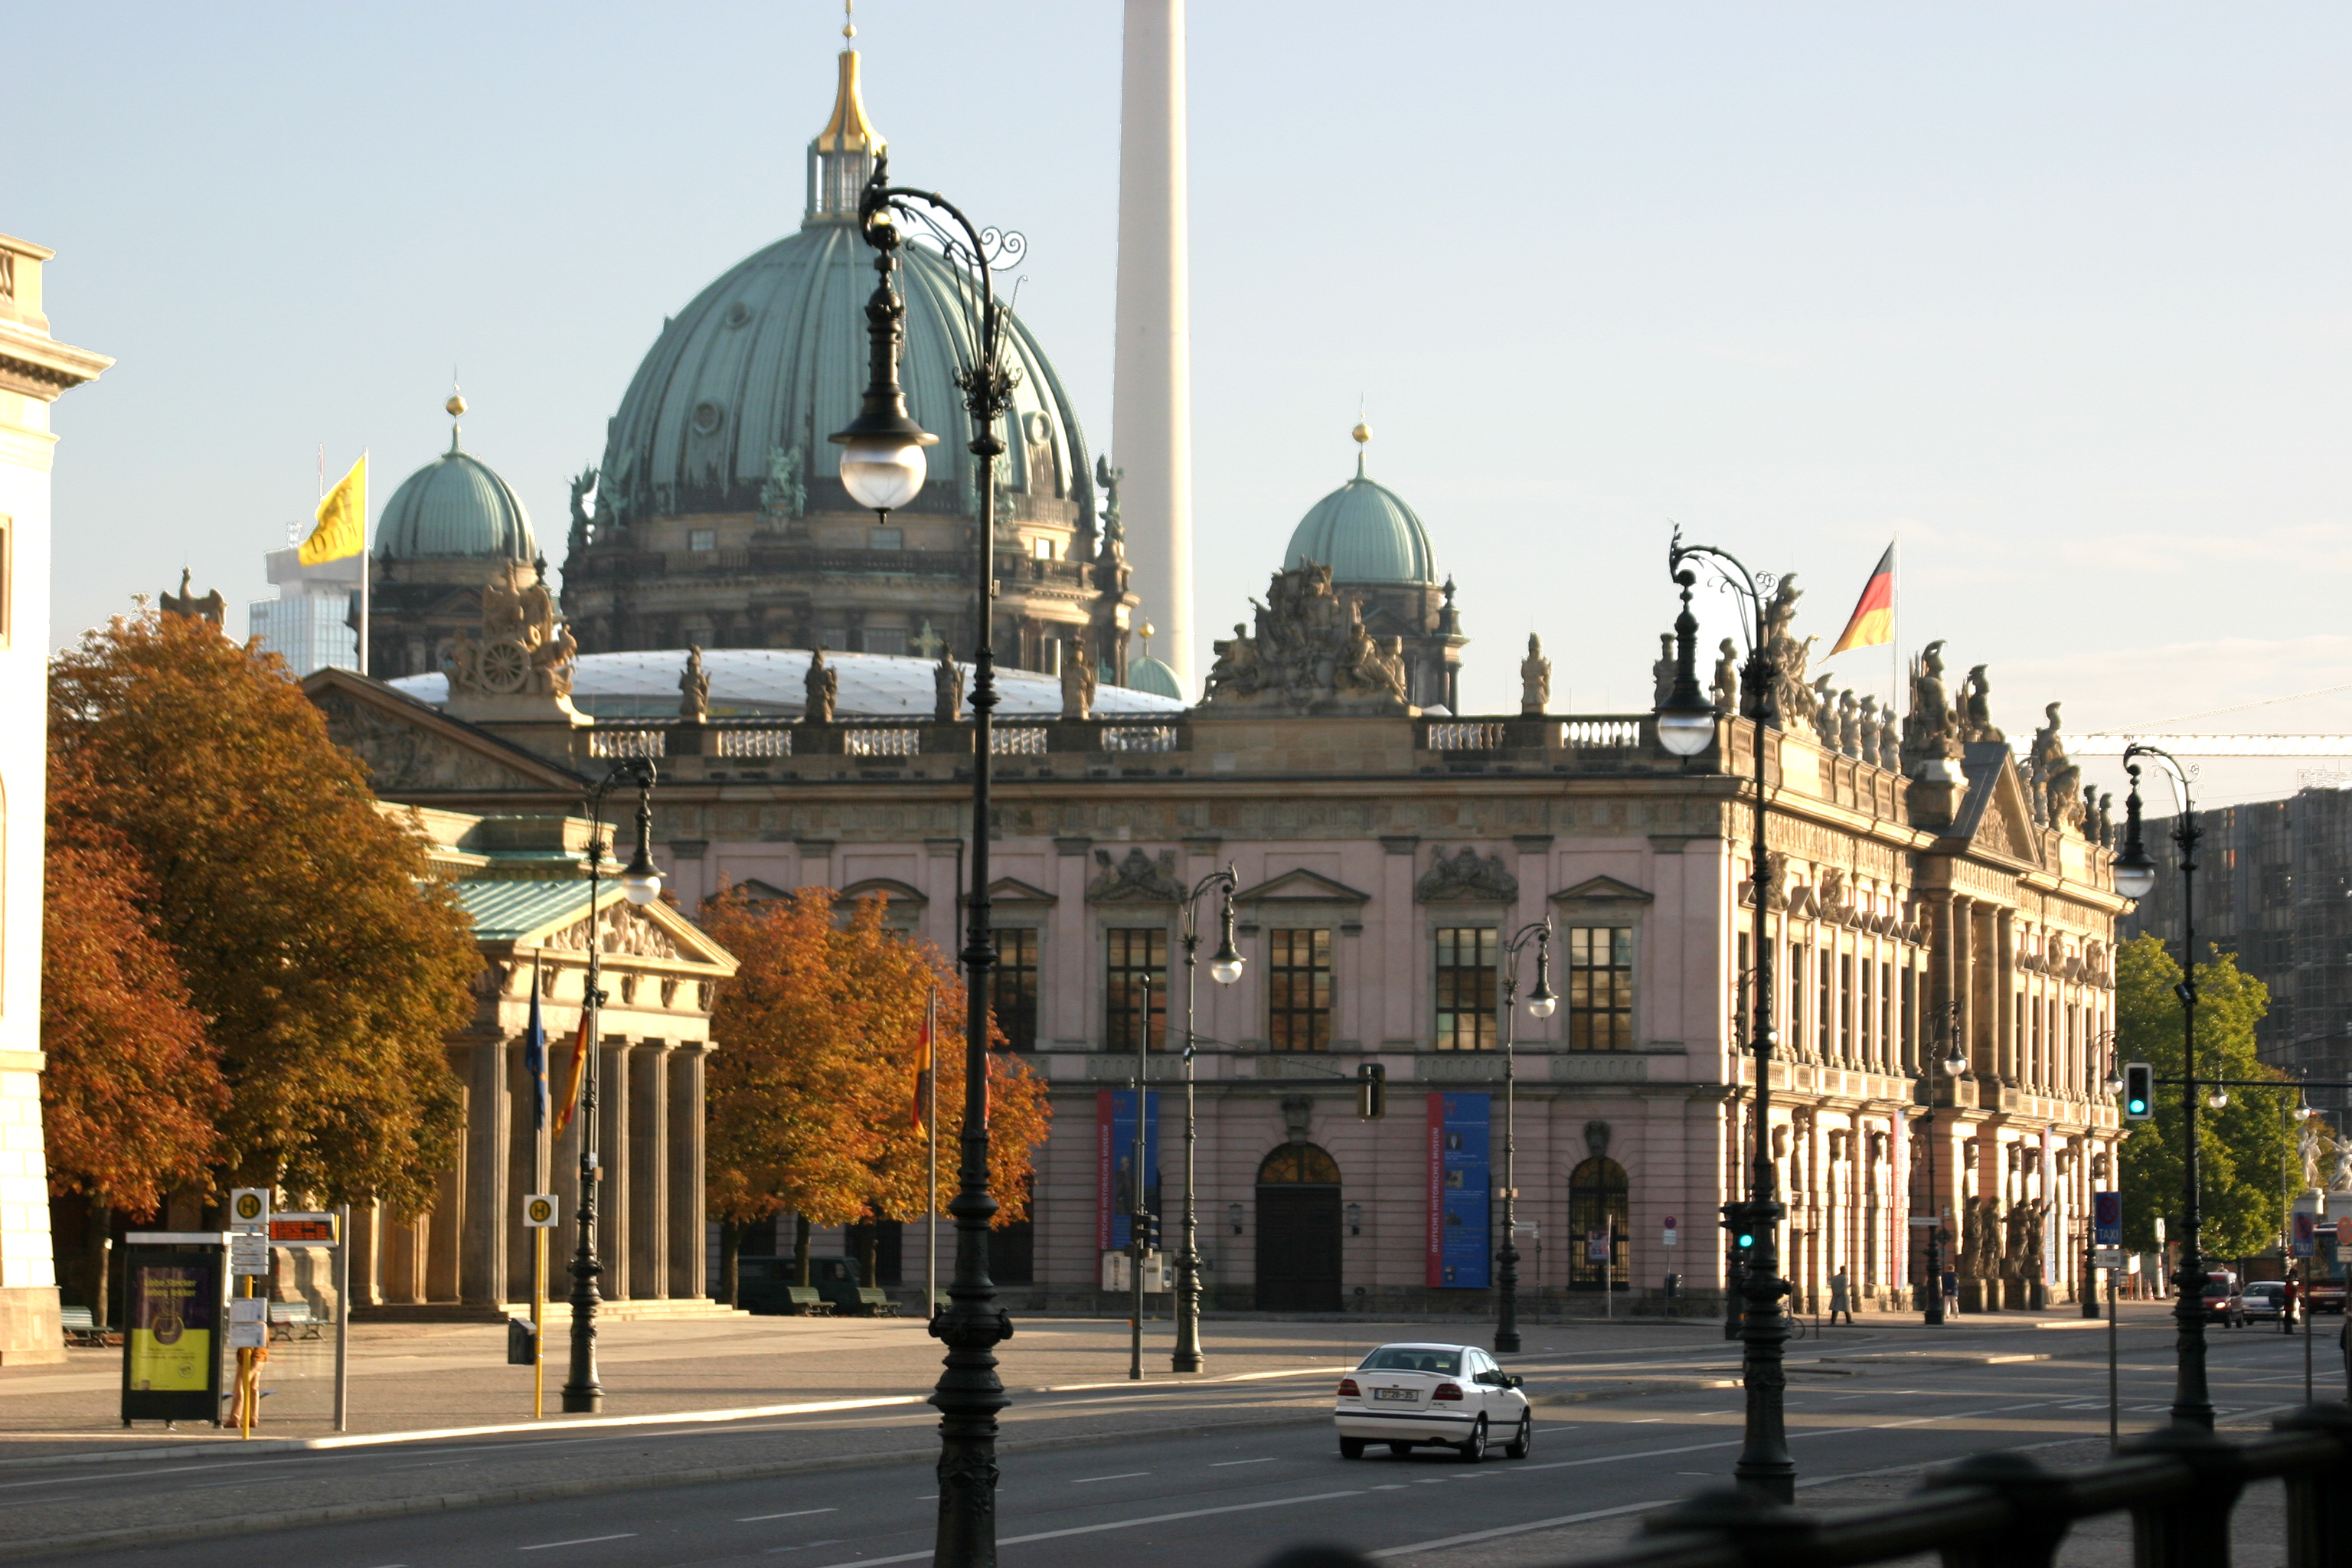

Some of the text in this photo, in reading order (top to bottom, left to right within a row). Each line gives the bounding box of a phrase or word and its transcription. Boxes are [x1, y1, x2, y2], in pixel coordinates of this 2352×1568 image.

[243, 1199, 255, 1214] H
[535, 1204, 546, 1217] H
[2099, 1229, 2118, 1240] TAXI
[2295, 1243, 2312, 1253] TAXI
